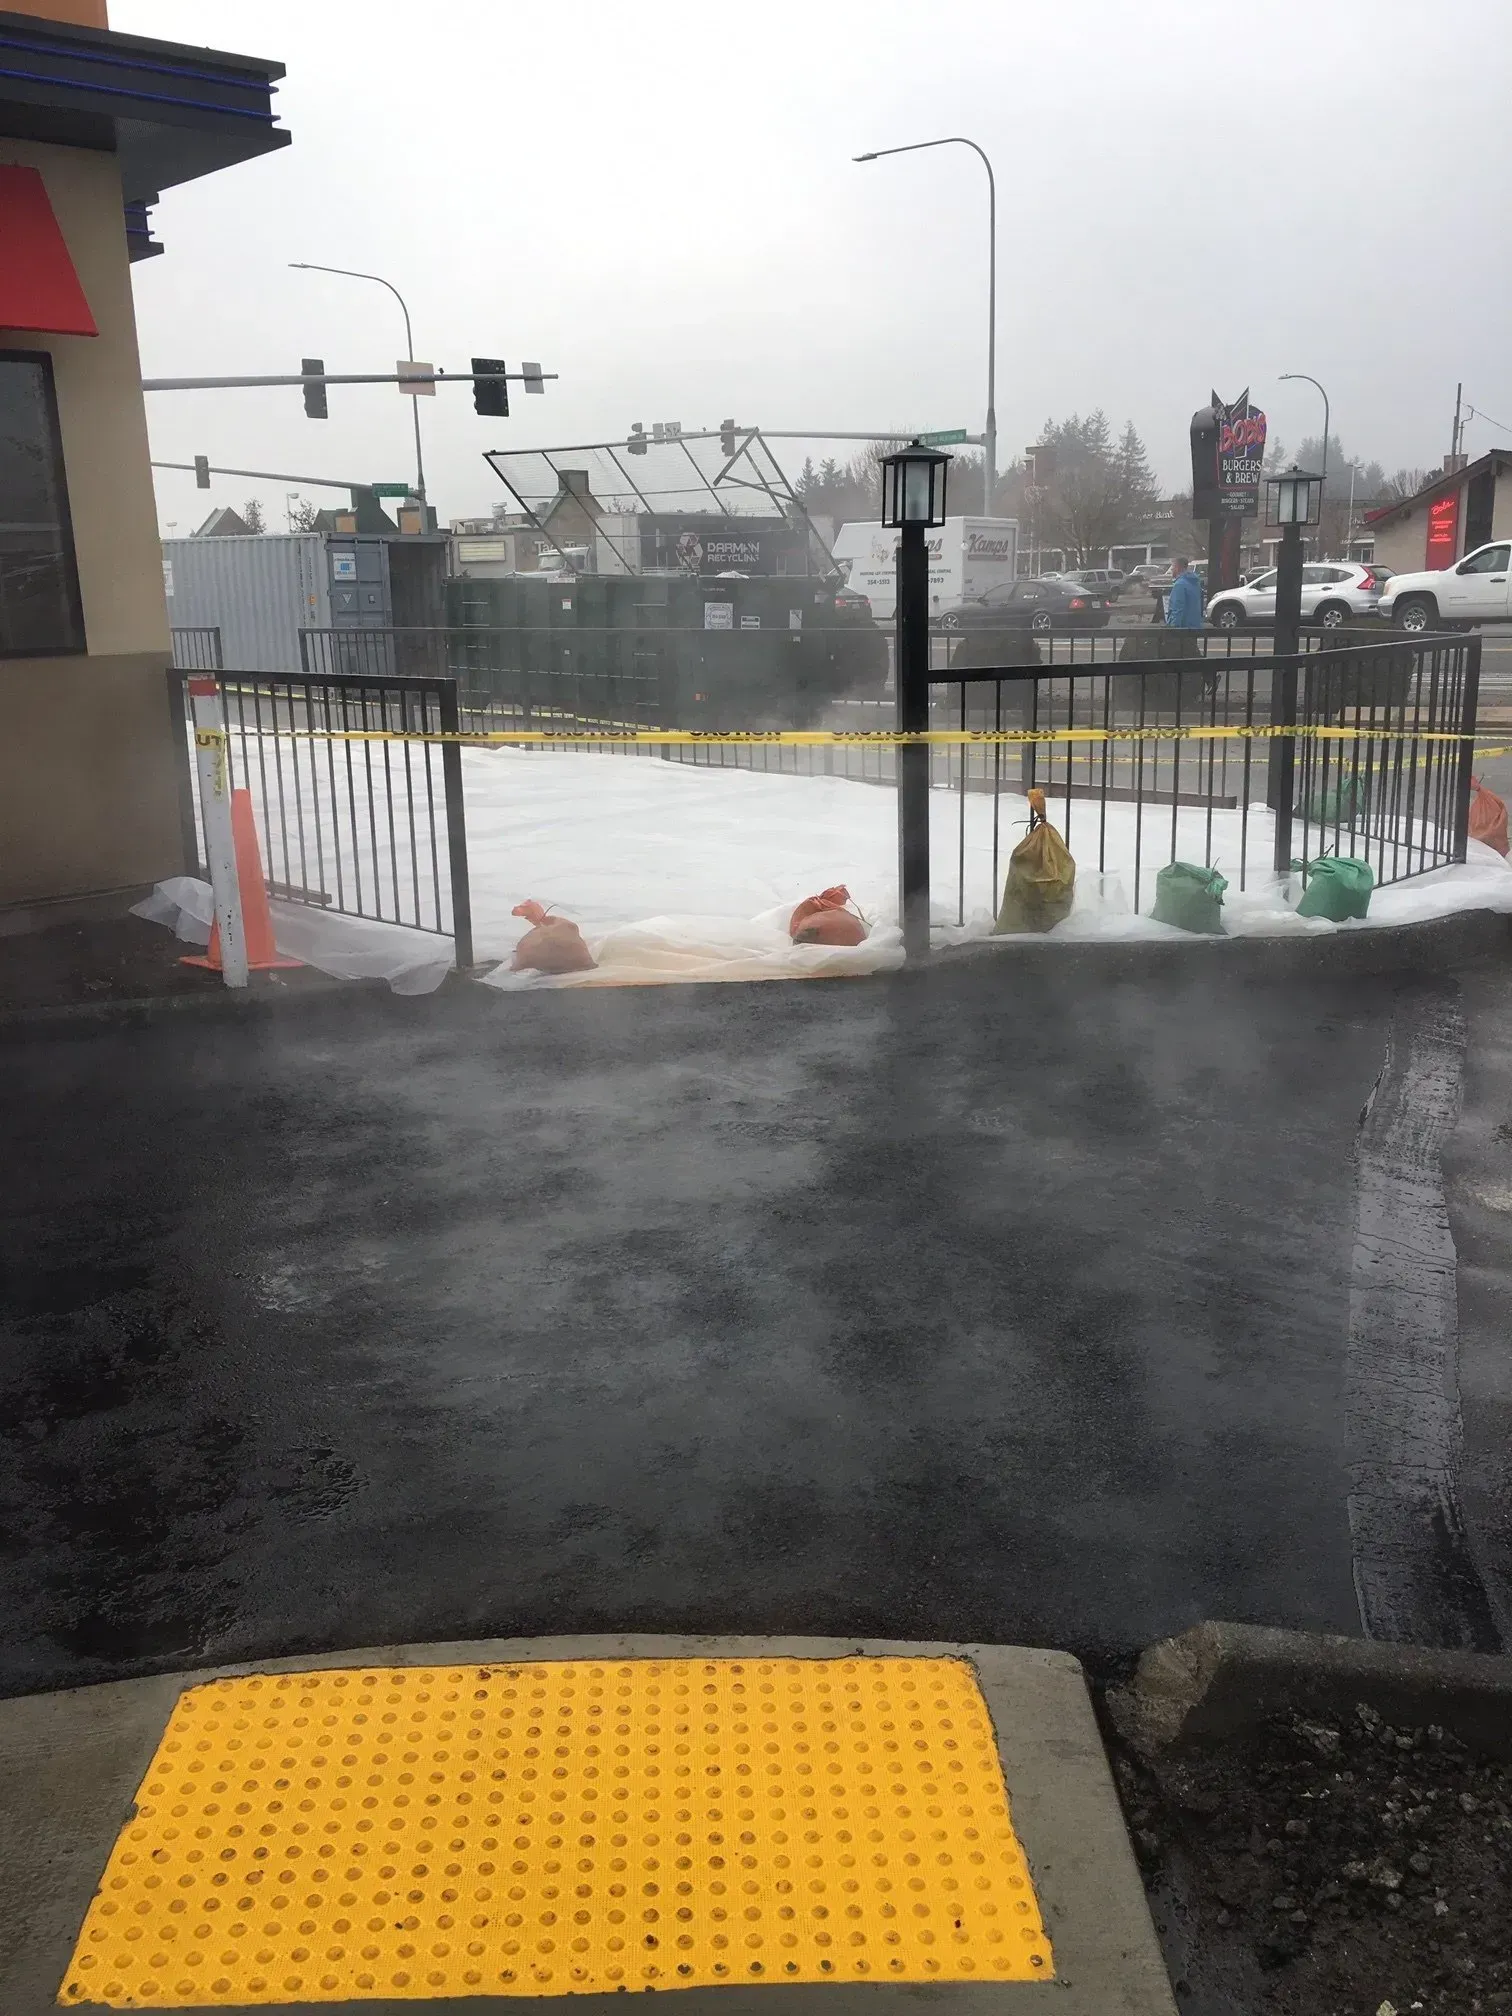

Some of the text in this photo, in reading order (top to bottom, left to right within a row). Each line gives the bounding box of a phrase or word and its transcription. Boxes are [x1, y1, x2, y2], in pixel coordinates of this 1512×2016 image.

[1223, 460, 1261, 471] BURGERS
[1225, 473, 1259, 484] & BREW
[968, 533, 1009, 556] Kamps
